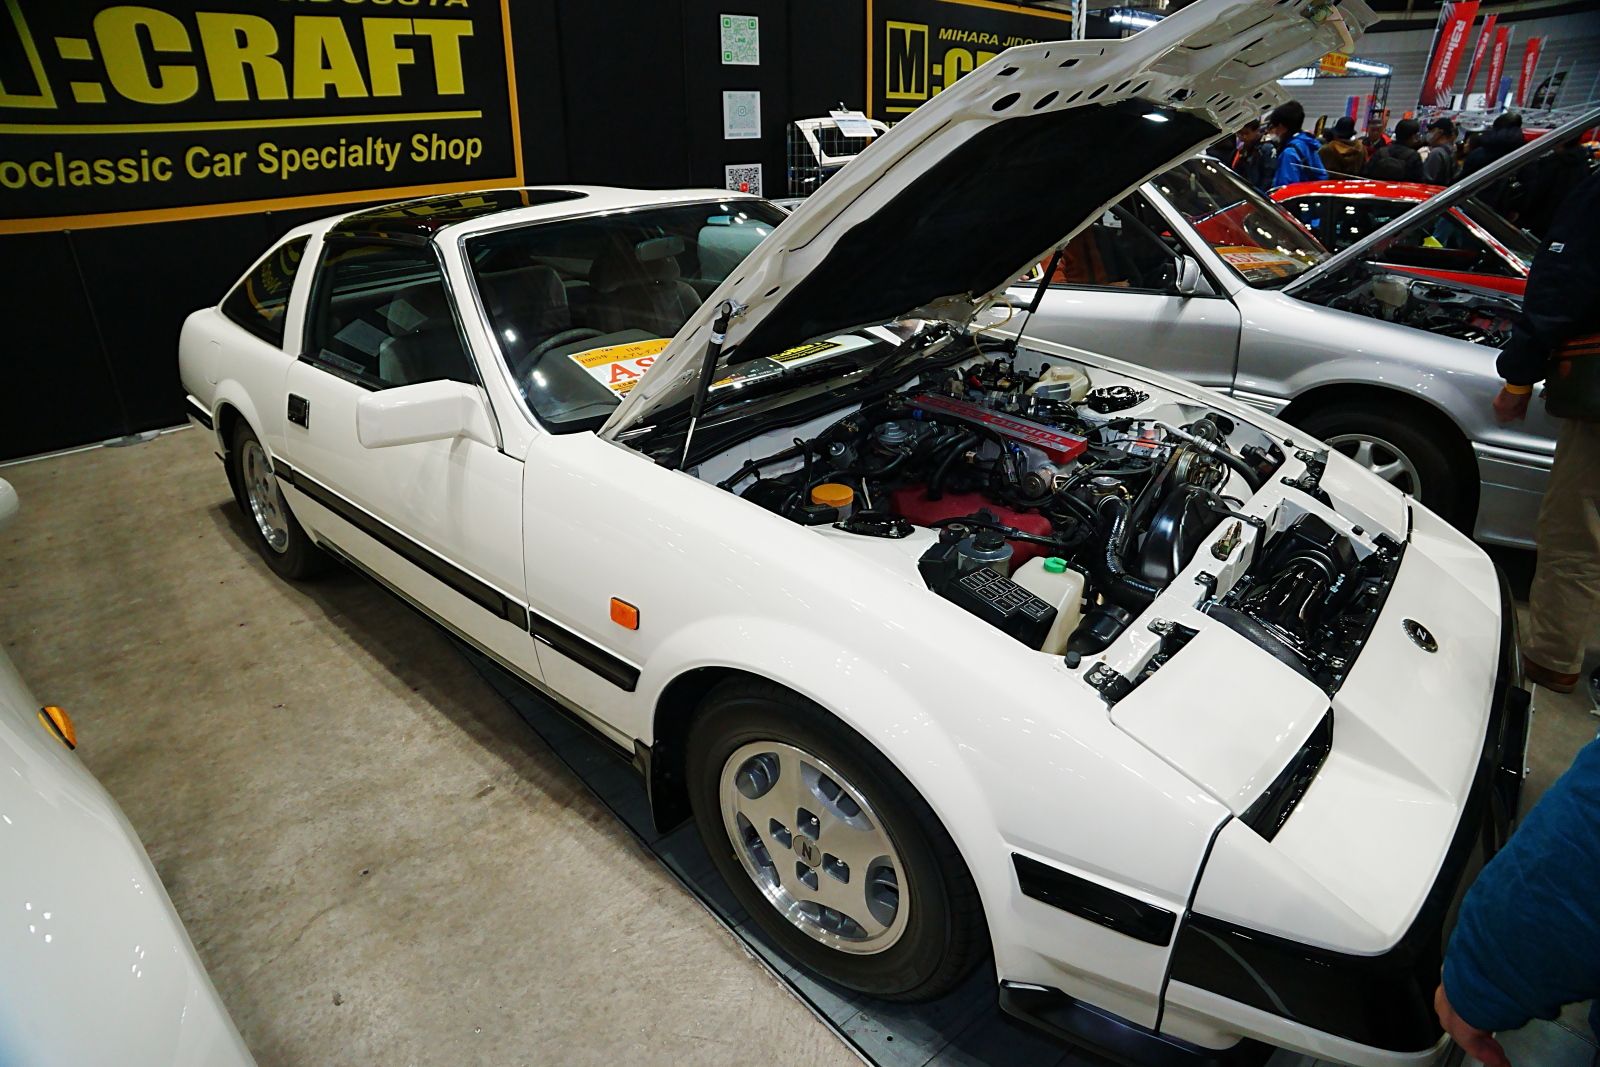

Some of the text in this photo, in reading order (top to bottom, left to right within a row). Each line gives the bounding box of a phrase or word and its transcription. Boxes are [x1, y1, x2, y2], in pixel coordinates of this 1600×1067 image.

[938, 28, 1039, 47] MIHARA JIDO
[0, 133, 483, 189] oclassic Car Specialty Shop
[608, 356, 656, 383] AS
